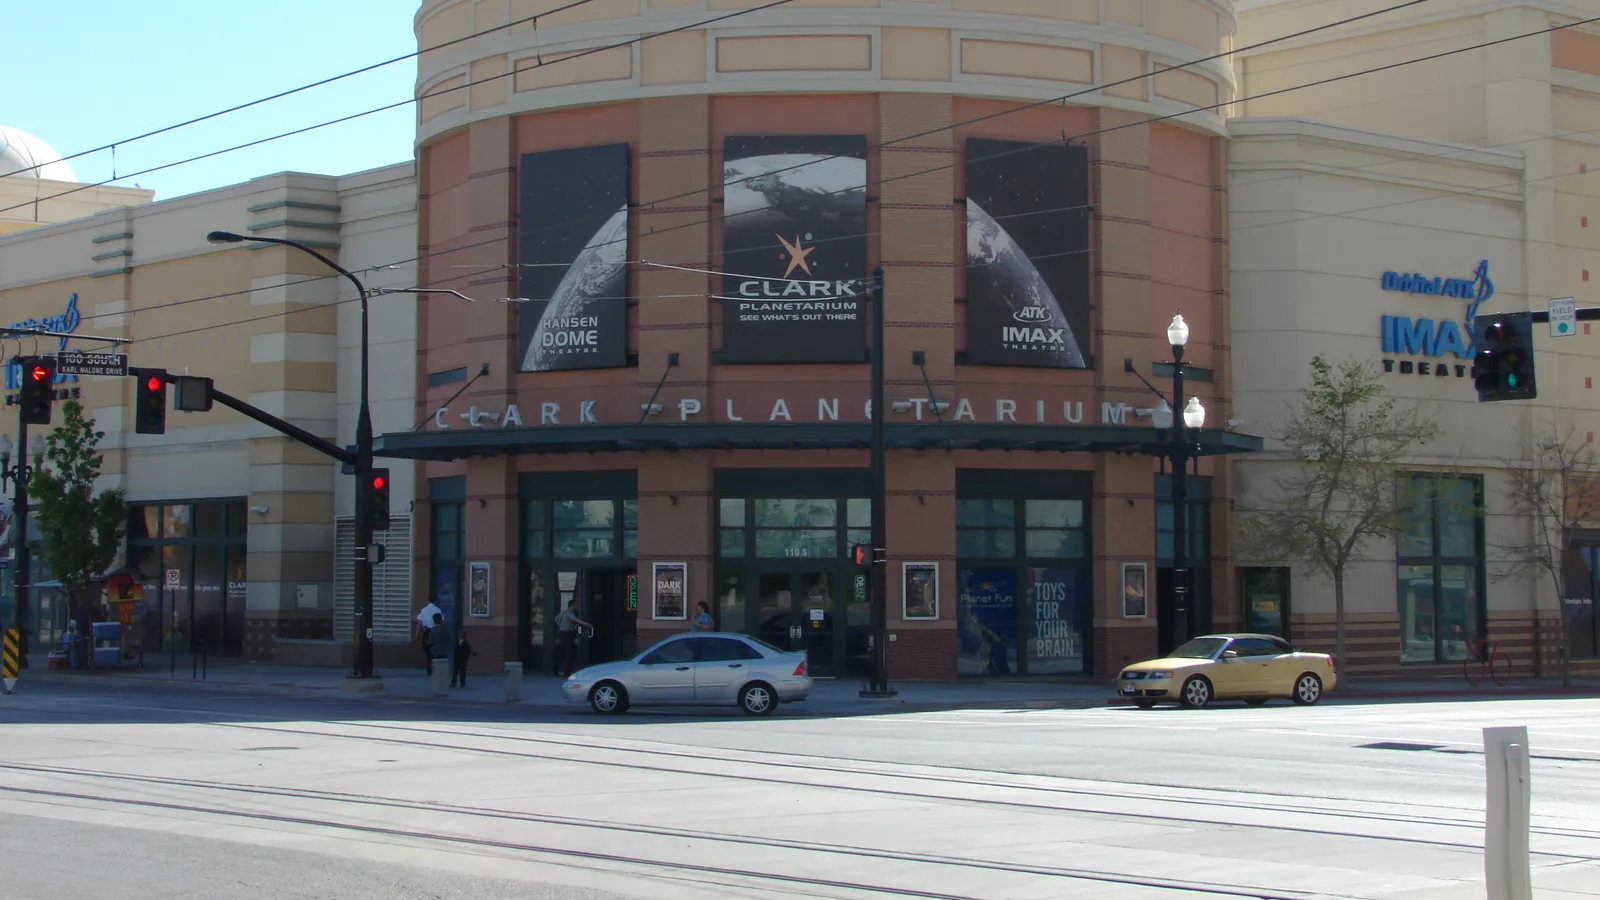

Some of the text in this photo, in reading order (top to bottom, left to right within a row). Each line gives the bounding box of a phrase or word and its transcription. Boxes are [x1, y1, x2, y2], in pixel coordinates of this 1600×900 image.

[739, 280, 857, 297] CLARK
[1382, 271, 1475, 299] Orbital ATK
[739, 302, 857, 311] PLANETARIUM
[1019, 306, 1047, 319] ATK
[1552, 306, 1572, 315] YIELD
[543, 316, 598, 329] HANSEN
[542, 329, 598, 347] DOME
[1002, 326, 1065, 344] IMAX
[1003, 343, 1066, 352] THEATRE
[66, 353, 121, 366] 100 SOUTH
[79, 366, 104, 375] MALONE
[105, 367, 123, 376] DRIVE
[435, 400, 597, 428] CLARK
[785, 547, 808, 557] 110 S
[658, 580, 681, 589] DARK
[629, 576, 638, 609] OPEN
[960, 593, 1013, 603] Planet Fun
[1034, 582, 1066, 601] TOYS
[1036, 602, 1059, 620] FOR
[1036, 620, 1068, 639] YOUR
